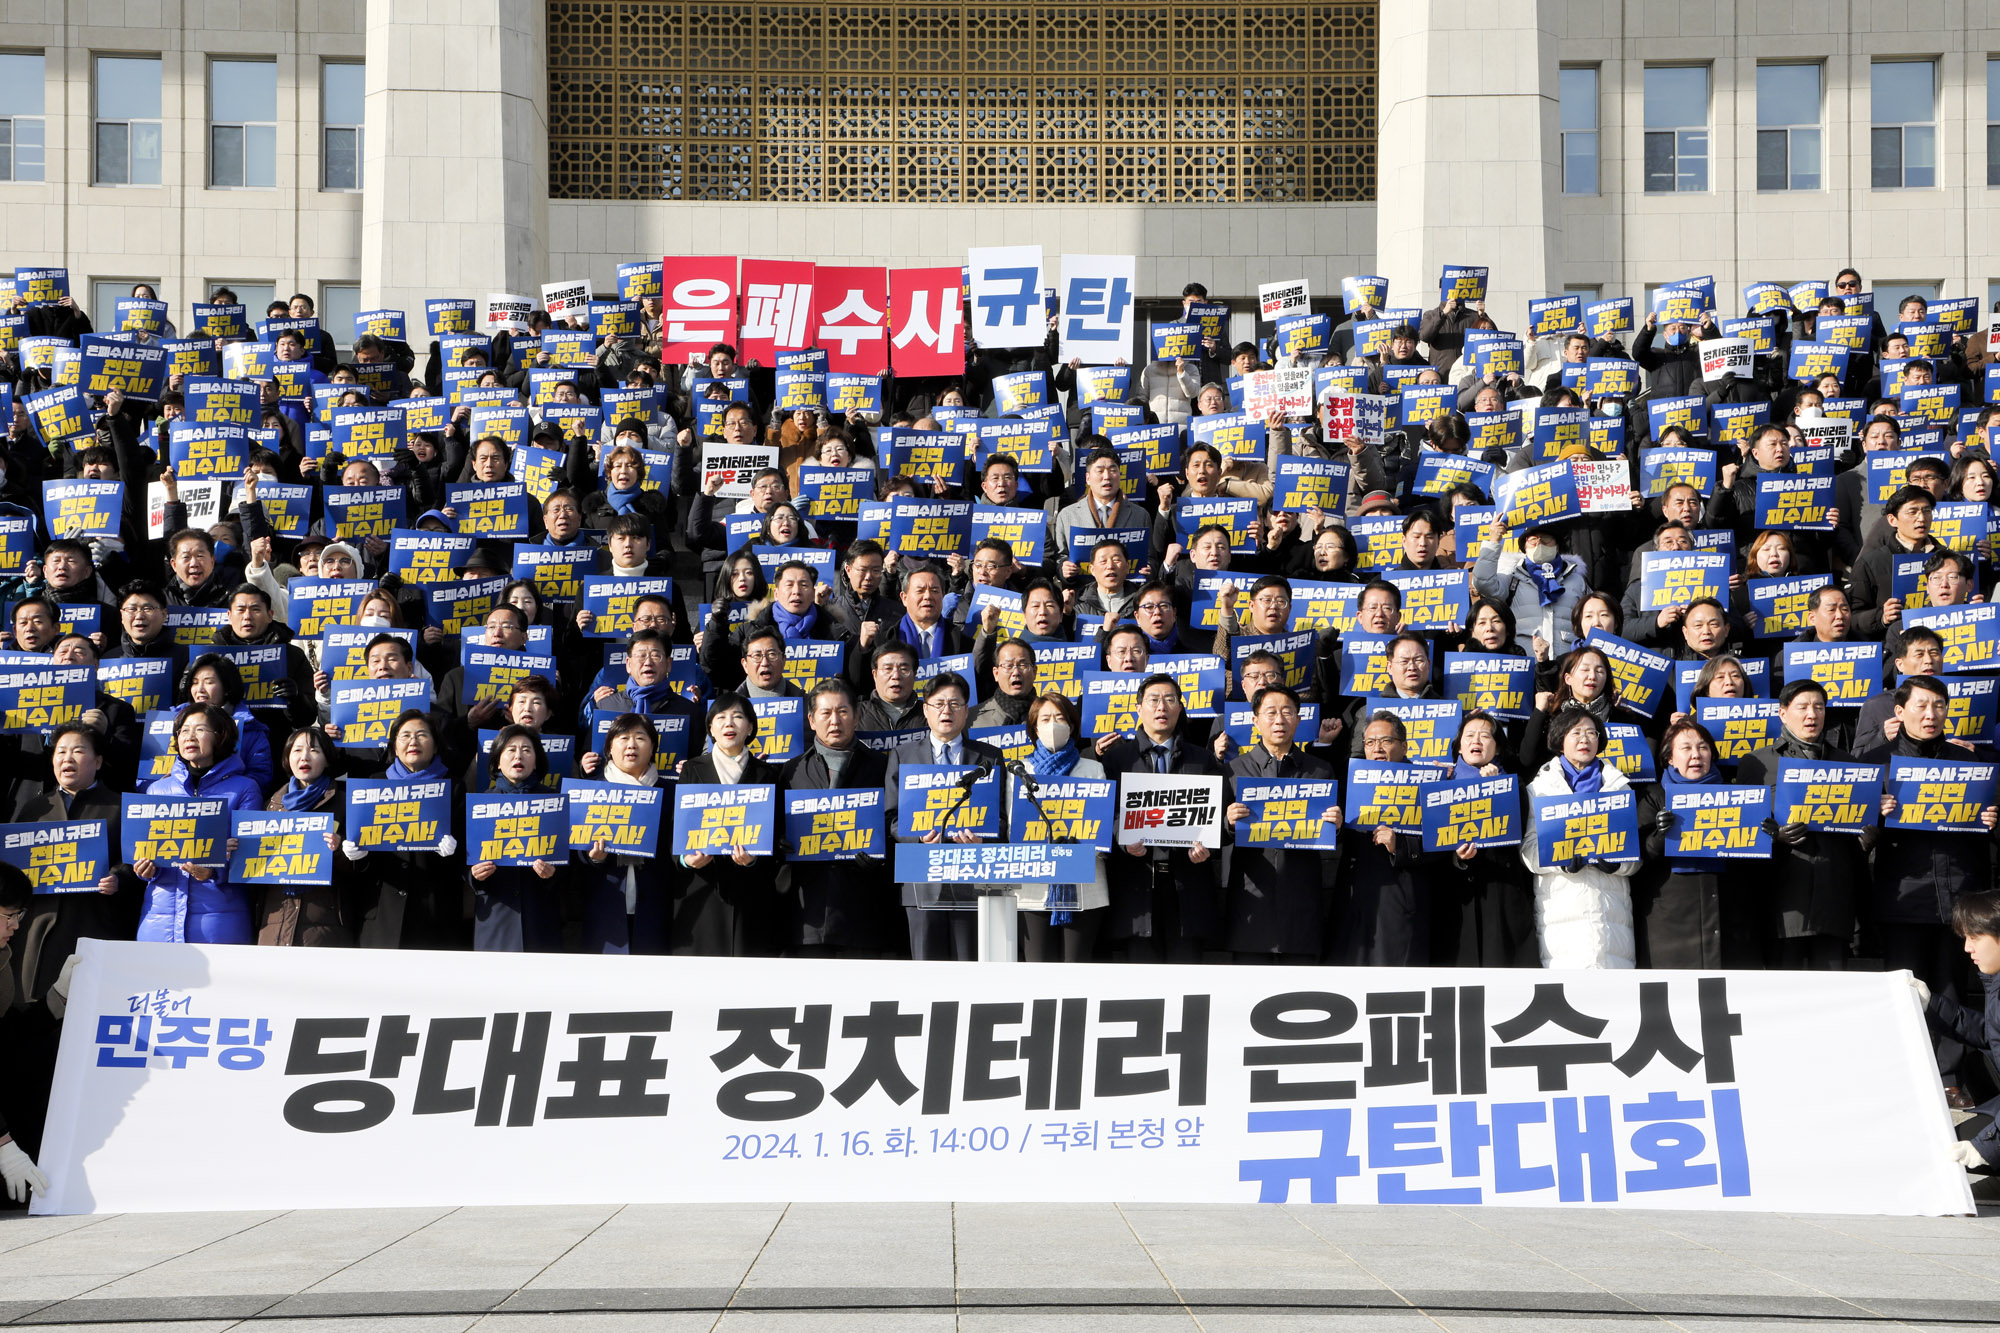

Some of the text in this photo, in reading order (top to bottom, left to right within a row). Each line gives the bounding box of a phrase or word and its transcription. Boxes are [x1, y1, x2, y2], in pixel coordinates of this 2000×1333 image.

[546, 286, 585, 302] 정치테러범
[977, 267, 1040, 326] 규
[1263, 286, 1302, 302] 정치테러범
[1264, 295, 1306, 313] 배후 공개!
[490, 302, 531, 312] 정치테러범
[547, 300, 565, 313] 배후
[666, 279, 730, 342] 은
[1066, 277, 1132, 341] 탄
[1531, 297, 1578, 312] 은폐수사 규탄!
[489, 312, 508, 322] 배후
[740, 283, 812, 347] 폐
[819, 289, 884, 355] 수
[892, 287, 962, 354] 사
[1543, 310, 1567, 322] 전면
[1536, 319, 1576, 333] 재수사!
[86, 345, 164, 361] 은폐수사 규탄!
[1704, 345, 1748, 361] 정치테러범
[102, 359, 142, 377] 전면
[1705, 355, 1751, 372] 배후 공개!
[88, 374, 153, 393] 재수사!
[829, 377, 879, 387] 은폐수사 규탄!
[1277, 380, 1304, 391] 믿을래?
[1284, 370, 1310, 381] 믿을래?
[839, 386, 865, 398] 전면
[1278, 395, 1311, 411] 잡아라!
[1327, 396, 1384, 417] 공범 잡아야
[172, 427, 244, 444] 은폐수사 규탄!
[1328, 418, 1384, 440] 암살 막는다
[188, 440, 226, 459] 전면
[177, 457, 241, 477] 재수사!
[706, 455, 770, 469] 정치테러범
[1280, 463, 1347, 477] 은폐수사 규탄!
[1572, 463, 1621, 475] 살인마 믿냐?
[1296, 476, 1334, 492] 전면
[1590, 473, 1611, 485] 믿냐?
[1761, 477, 1832, 493] 은폐수사 규탄!
[451, 484, 523, 503] 은폐수사 규탄!
[1283, 492, 1340, 509] 재수사!
[1593, 484, 1630, 499] 잡아라!
[1777, 491, 1814, 507] 전면
[469, 499, 505, 518] 전면
[896, 503, 970, 517] 은폐수사 규탄!
[1765, 506, 1826, 525] 재수사!
[458, 514, 519, 534] 재수사!
[912, 517, 950, 535] 전면
[899, 534, 962, 551] 재수사!
[1449, 659, 1531, 674] 은폐수사 규탄!
[1469, 673, 1510, 692] 전면
[1457, 691, 1524, 710] 재수사!
[1783, 768, 1880, 783] 은폐수사 규탄!
[1896, 766, 1994, 782] 은폐수사 규탄!
[351, 782, 446, 804] 은폐수사 규탄!
[567, 789, 658, 804] 은폐수사 규탄!
[680, 787, 770, 810] 은폐수사 규탄!
[1126, 788, 1210, 808] 정치테러범
[1242, 783, 1333, 801] 은폐수사 규탄!
[1427, 777, 1513, 807] 은폐수사 규탄!
[1672, 788, 1766, 809] 은폐수사 규탄!
[1804, 784, 1853, 804] 전면
[1916, 783, 1967, 803] 전면
[127, 801, 223, 819] 은폐수사 규탄!
[472, 797, 565, 819] 은폐수사 규탄!
[791, 791, 879, 814] 은폐수사 규탄!
[1262, 799, 1308, 821] 전면
[1449, 798, 1492, 824] 전면
[1541, 793, 1630, 822] 은폐수사 규탄!
[373, 801, 421, 825] 전면
[584, 805, 632, 824] 전면
[701, 805, 746, 829] 전면
[812, 810, 856, 834] 전면
[1124, 807, 1216, 830] 배후 공개!
[1694, 807, 1741, 830] 전면
[1787, 804, 1868, 826] 재수사!
[1899, 803, 1982, 823] 재수사!
[5, 822, 101, 848] 은폐수사 규탄!
[148, 818, 197, 840] 전면
[237, 816, 329, 836] 은폐수사 규탄!
[358, 820, 438, 846] 재수사!
[494, 816, 540, 839] 전면
[568, 825, 647, 845] 재수사!
[1248, 819, 1324, 842] 재수사!
[1436, 815, 1509, 847] 재수사!
[1565, 813, 1609, 840] 전면
[258, 834, 305, 856] 전면
[685, 824, 762, 850] 재수사!
[799, 828, 873, 856] 재수사!
[1552, 831, 1627, 862] 재수사!
[1678, 826, 1759, 852] 재수사!
[29, 841, 77, 867] 전면
[133, 838, 214, 861] 재수사!
[479, 834, 558, 861] 재수사!
[929, 845, 1047, 866] 당대표 정치테러
[1051, 848, 1073, 857] 민주당
[242, 854, 320, 878] 재수사!
[927, 861, 1056, 882] 은폐수사 규탄대회
[127, 988, 192, 1018] 더불어
[95, 1015, 272, 1070] 민주당
[283, 977, 1743, 1134] 당대표 정치테러 은폐수사
[722, 1116, 1206, 1160] 2024. 1. 16. 화. 14:00 / 국회 본청 앞
[1238, 1089, 1752, 1204] 규탄대회
